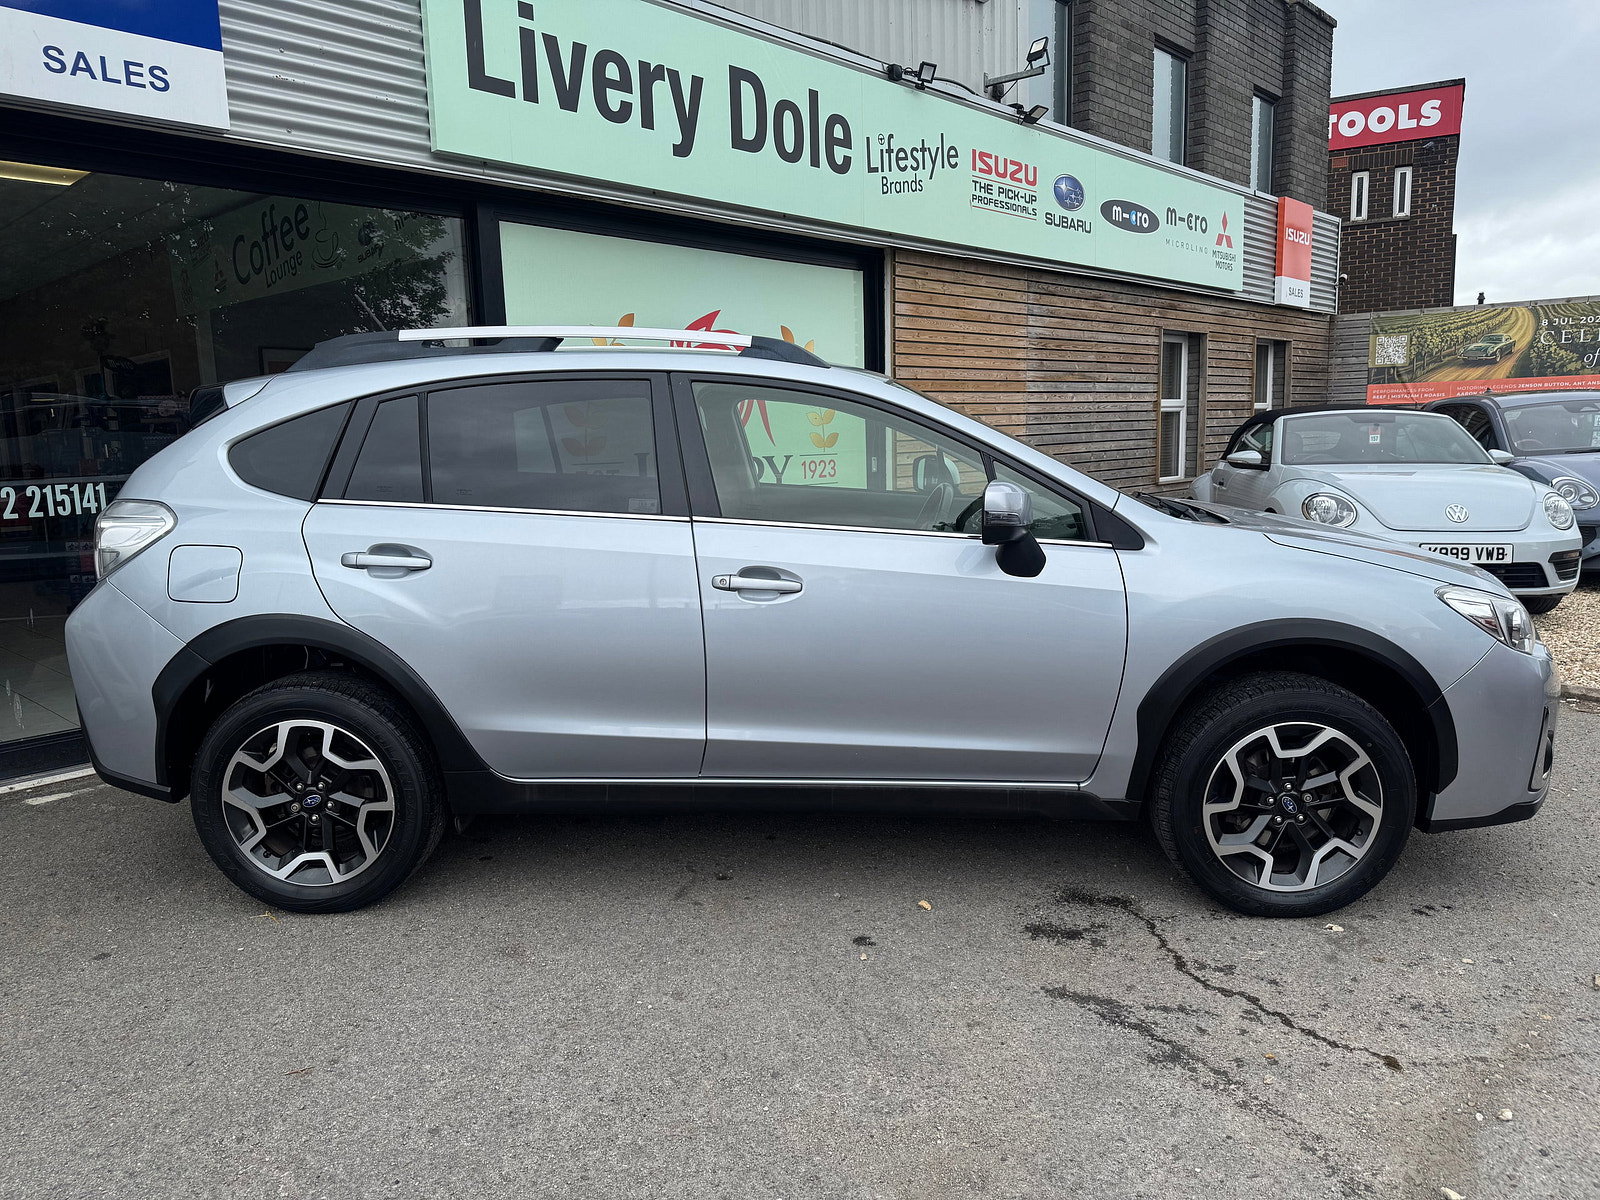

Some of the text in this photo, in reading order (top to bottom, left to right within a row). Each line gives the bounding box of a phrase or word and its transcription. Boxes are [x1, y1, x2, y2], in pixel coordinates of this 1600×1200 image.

[42, 45, 171, 93] SALES
[463, 0, 853, 175] Livery Dole
[865, 132, 959, 180] Lifestyle
[971, 148, 1037, 187] ISUZU
[881, 173, 924, 195] Brands
[972, 179, 1037, 205] THE PICK-UP
[971, 193, 1038, 217] PROFESSIONALS
[1044, 211, 1092, 234] SUBARU
[232, 203, 310, 285] Coffee
[1285, 226, 1311, 246] ISUZU
[1212, 249, 1237, 263] MITSUBISHI
[1215, 260, 1234, 272] MOTORS
[264, 250, 303, 289] Lounge
[1288, 286, 1304, 299] SALES
[1541, 318, 1549, 326] 8
[1552, 317, 1576, 326] JUL
[1540, 327, 1600, 345] CEL
[1583, 347, 1600, 369] of
[801, 459, 837, 479] 1923
[25, 482, 108, 518] 215141
[1475, 546, 1506, 561] VWB
